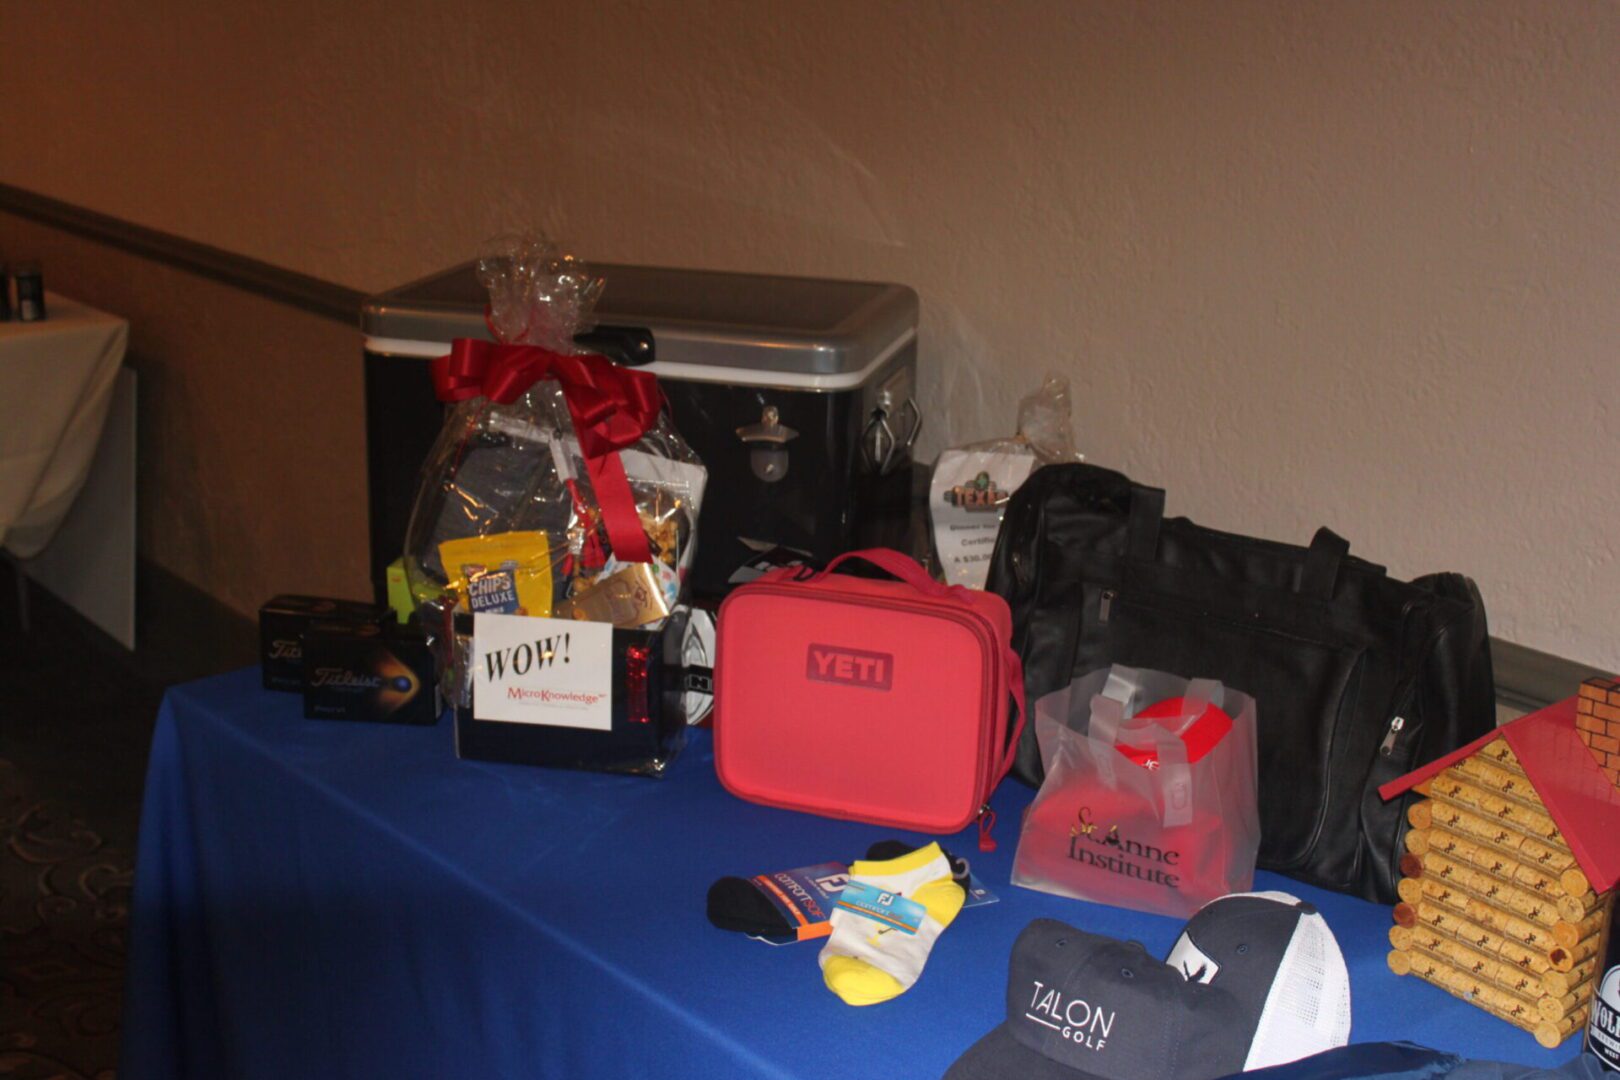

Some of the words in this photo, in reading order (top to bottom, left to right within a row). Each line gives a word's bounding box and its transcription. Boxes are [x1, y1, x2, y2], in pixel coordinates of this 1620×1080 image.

[469, 576, 512, 596] CHIPS
[471, 590, 515, 608] DELUXE
[485, 632, 570, 682] WOW!
[814, 651, 884, 683] YETI
[312, 668, 382, 687] Titleist
[1067, 836, 1180, 888] Institute
[877, 892, 895, 906] FJ
[1030, 981, 1115, 1038] TALON
[1062, 1026, 1106, 1051] GOLF
